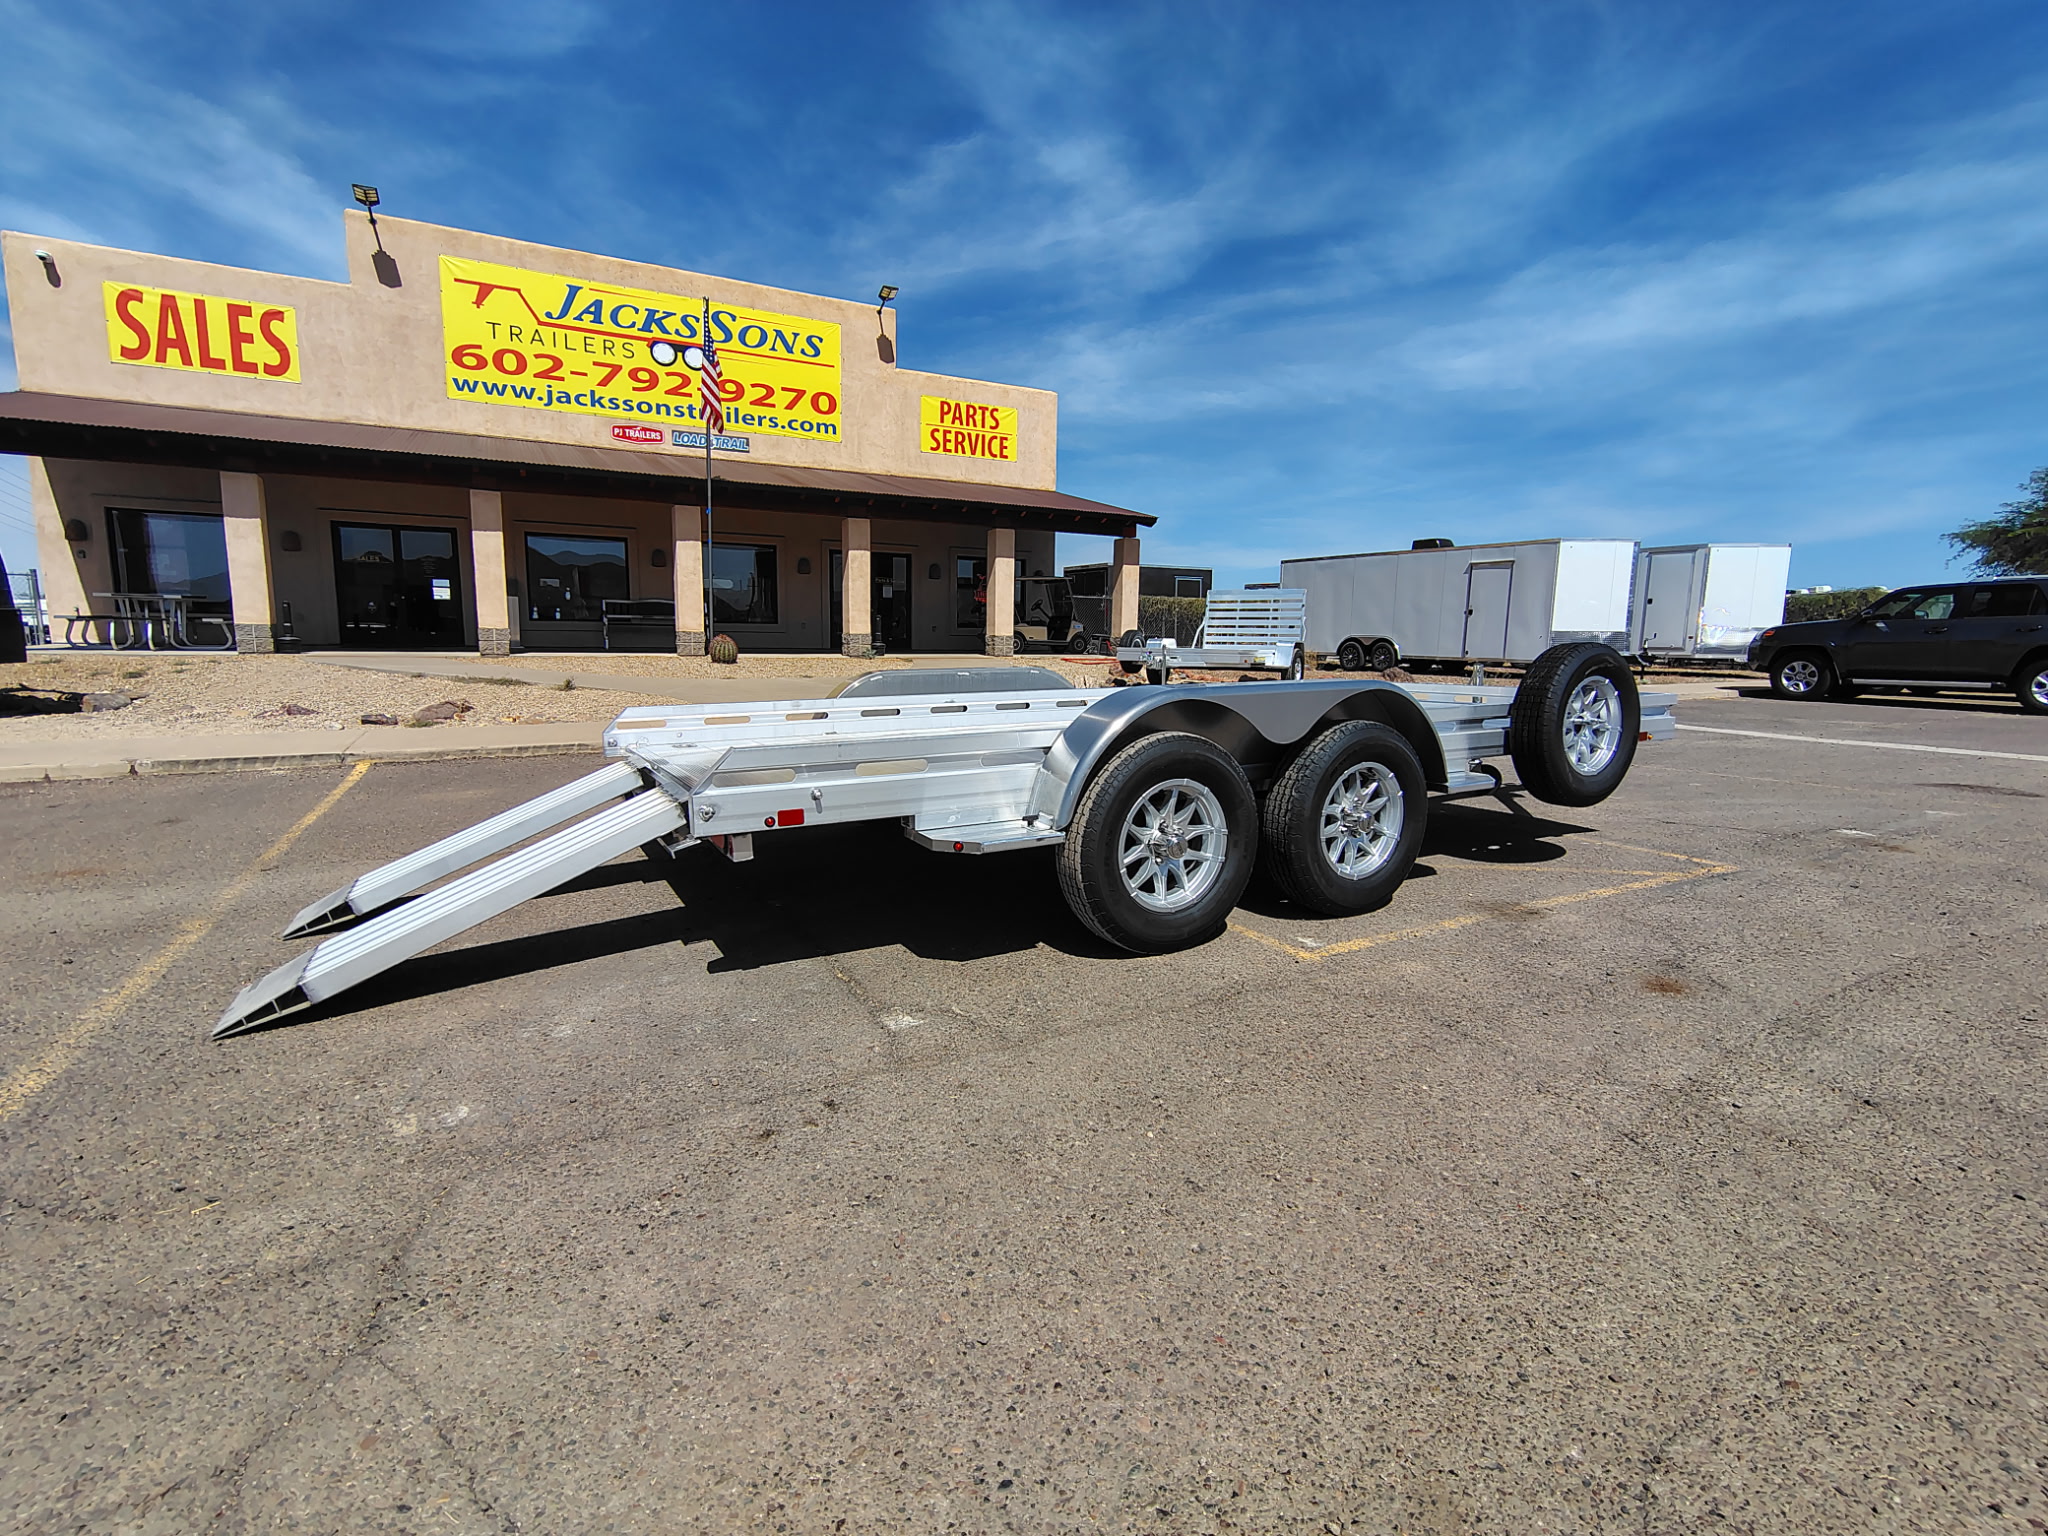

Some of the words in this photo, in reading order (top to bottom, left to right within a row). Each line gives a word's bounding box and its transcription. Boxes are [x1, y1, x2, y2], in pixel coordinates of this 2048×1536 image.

[115, 288, 291, 377] SALES
[485, 321, 635, 359] TRAILERS
[452, 377, 837, 435] www.jackssonstilers.com
[939, 401, 1000, 430] PARTS
[614, 428, 623, 436] PJ
[624, 428, 661, 440] TRAILERS
[673, 433, 707, 447] LOAD
[714, 437, 749, 450] TRAIL
[930, 428, 1009, 459] SERVICE
